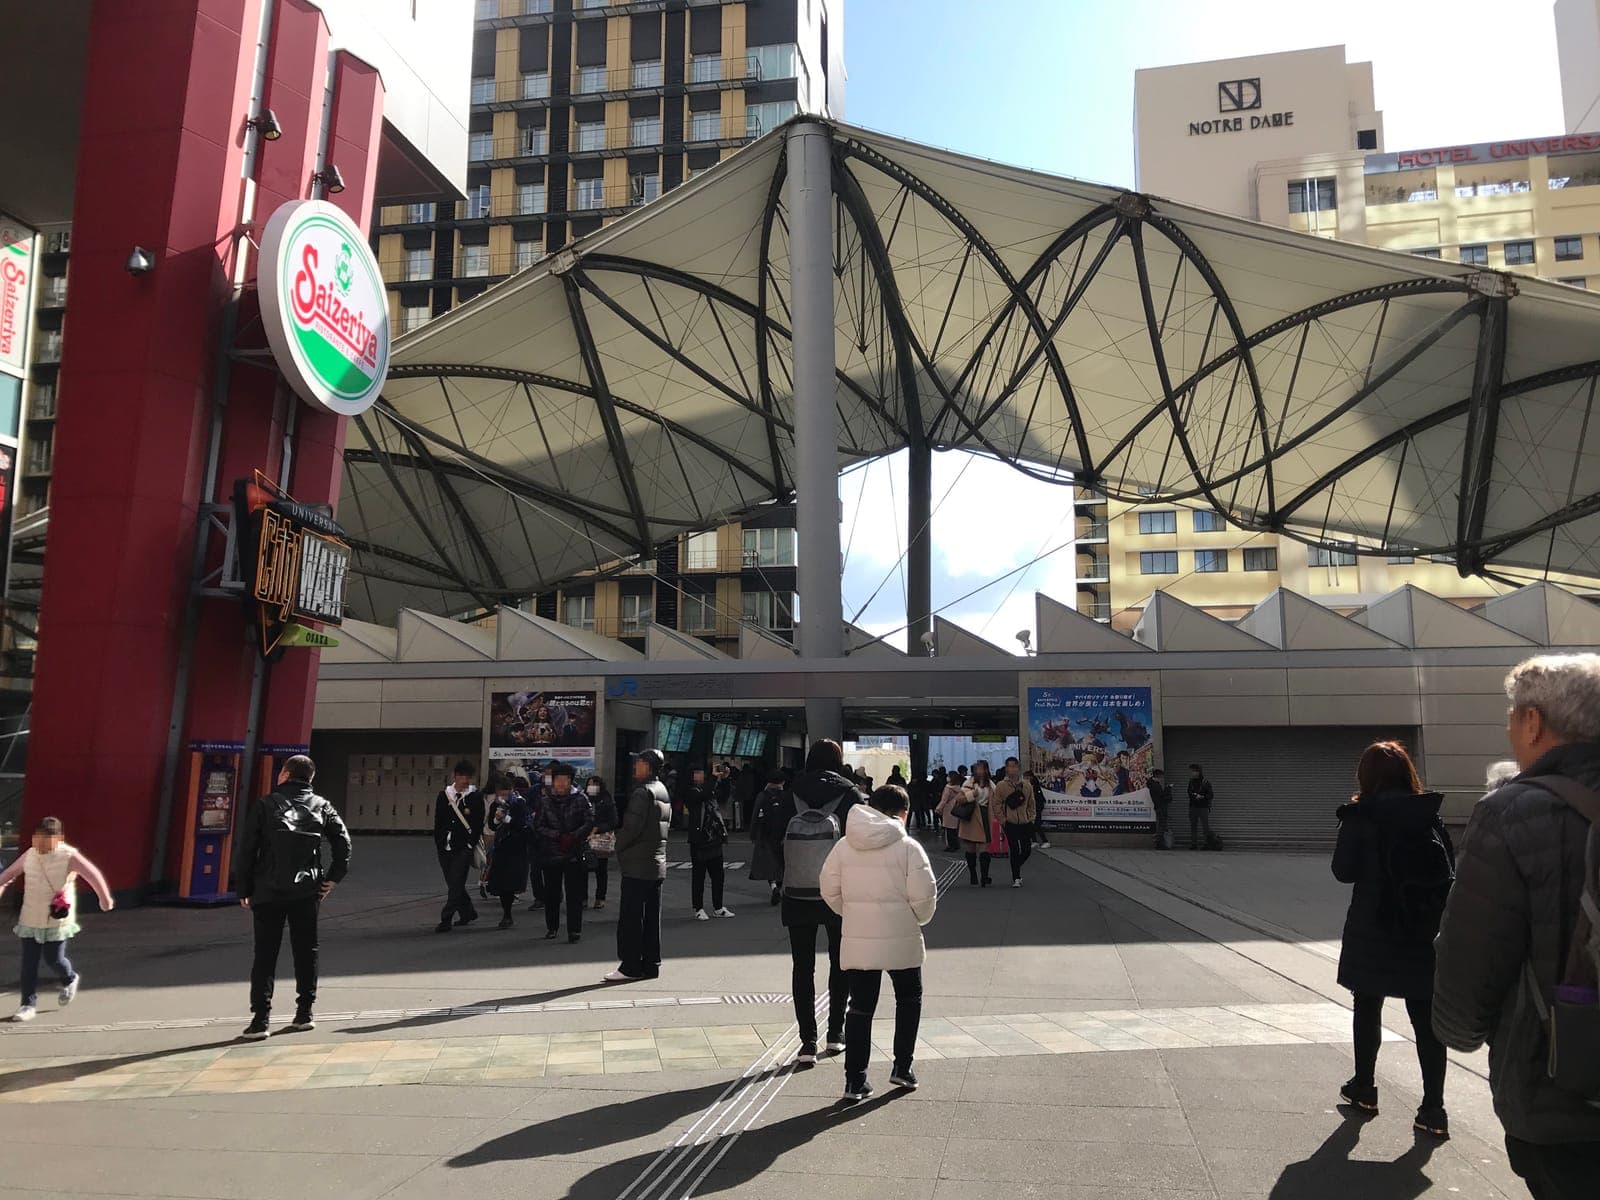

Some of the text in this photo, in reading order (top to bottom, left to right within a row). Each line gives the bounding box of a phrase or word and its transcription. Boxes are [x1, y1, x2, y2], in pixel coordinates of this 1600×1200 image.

[1189, 111, 1294, 136] NOTRE DAME
[1399, 147, 1479, 168] HOTEL
[0, 257, 25, 354] Saizeriya
[291, 244, 379, 367] Saizeriya
[291, 503, 337, 534] UNIVERSAL
[300, 534, 347, 618] WALK
[305, 631, 329, 645] OSAKA
[609, 679, 639, 697] JR
